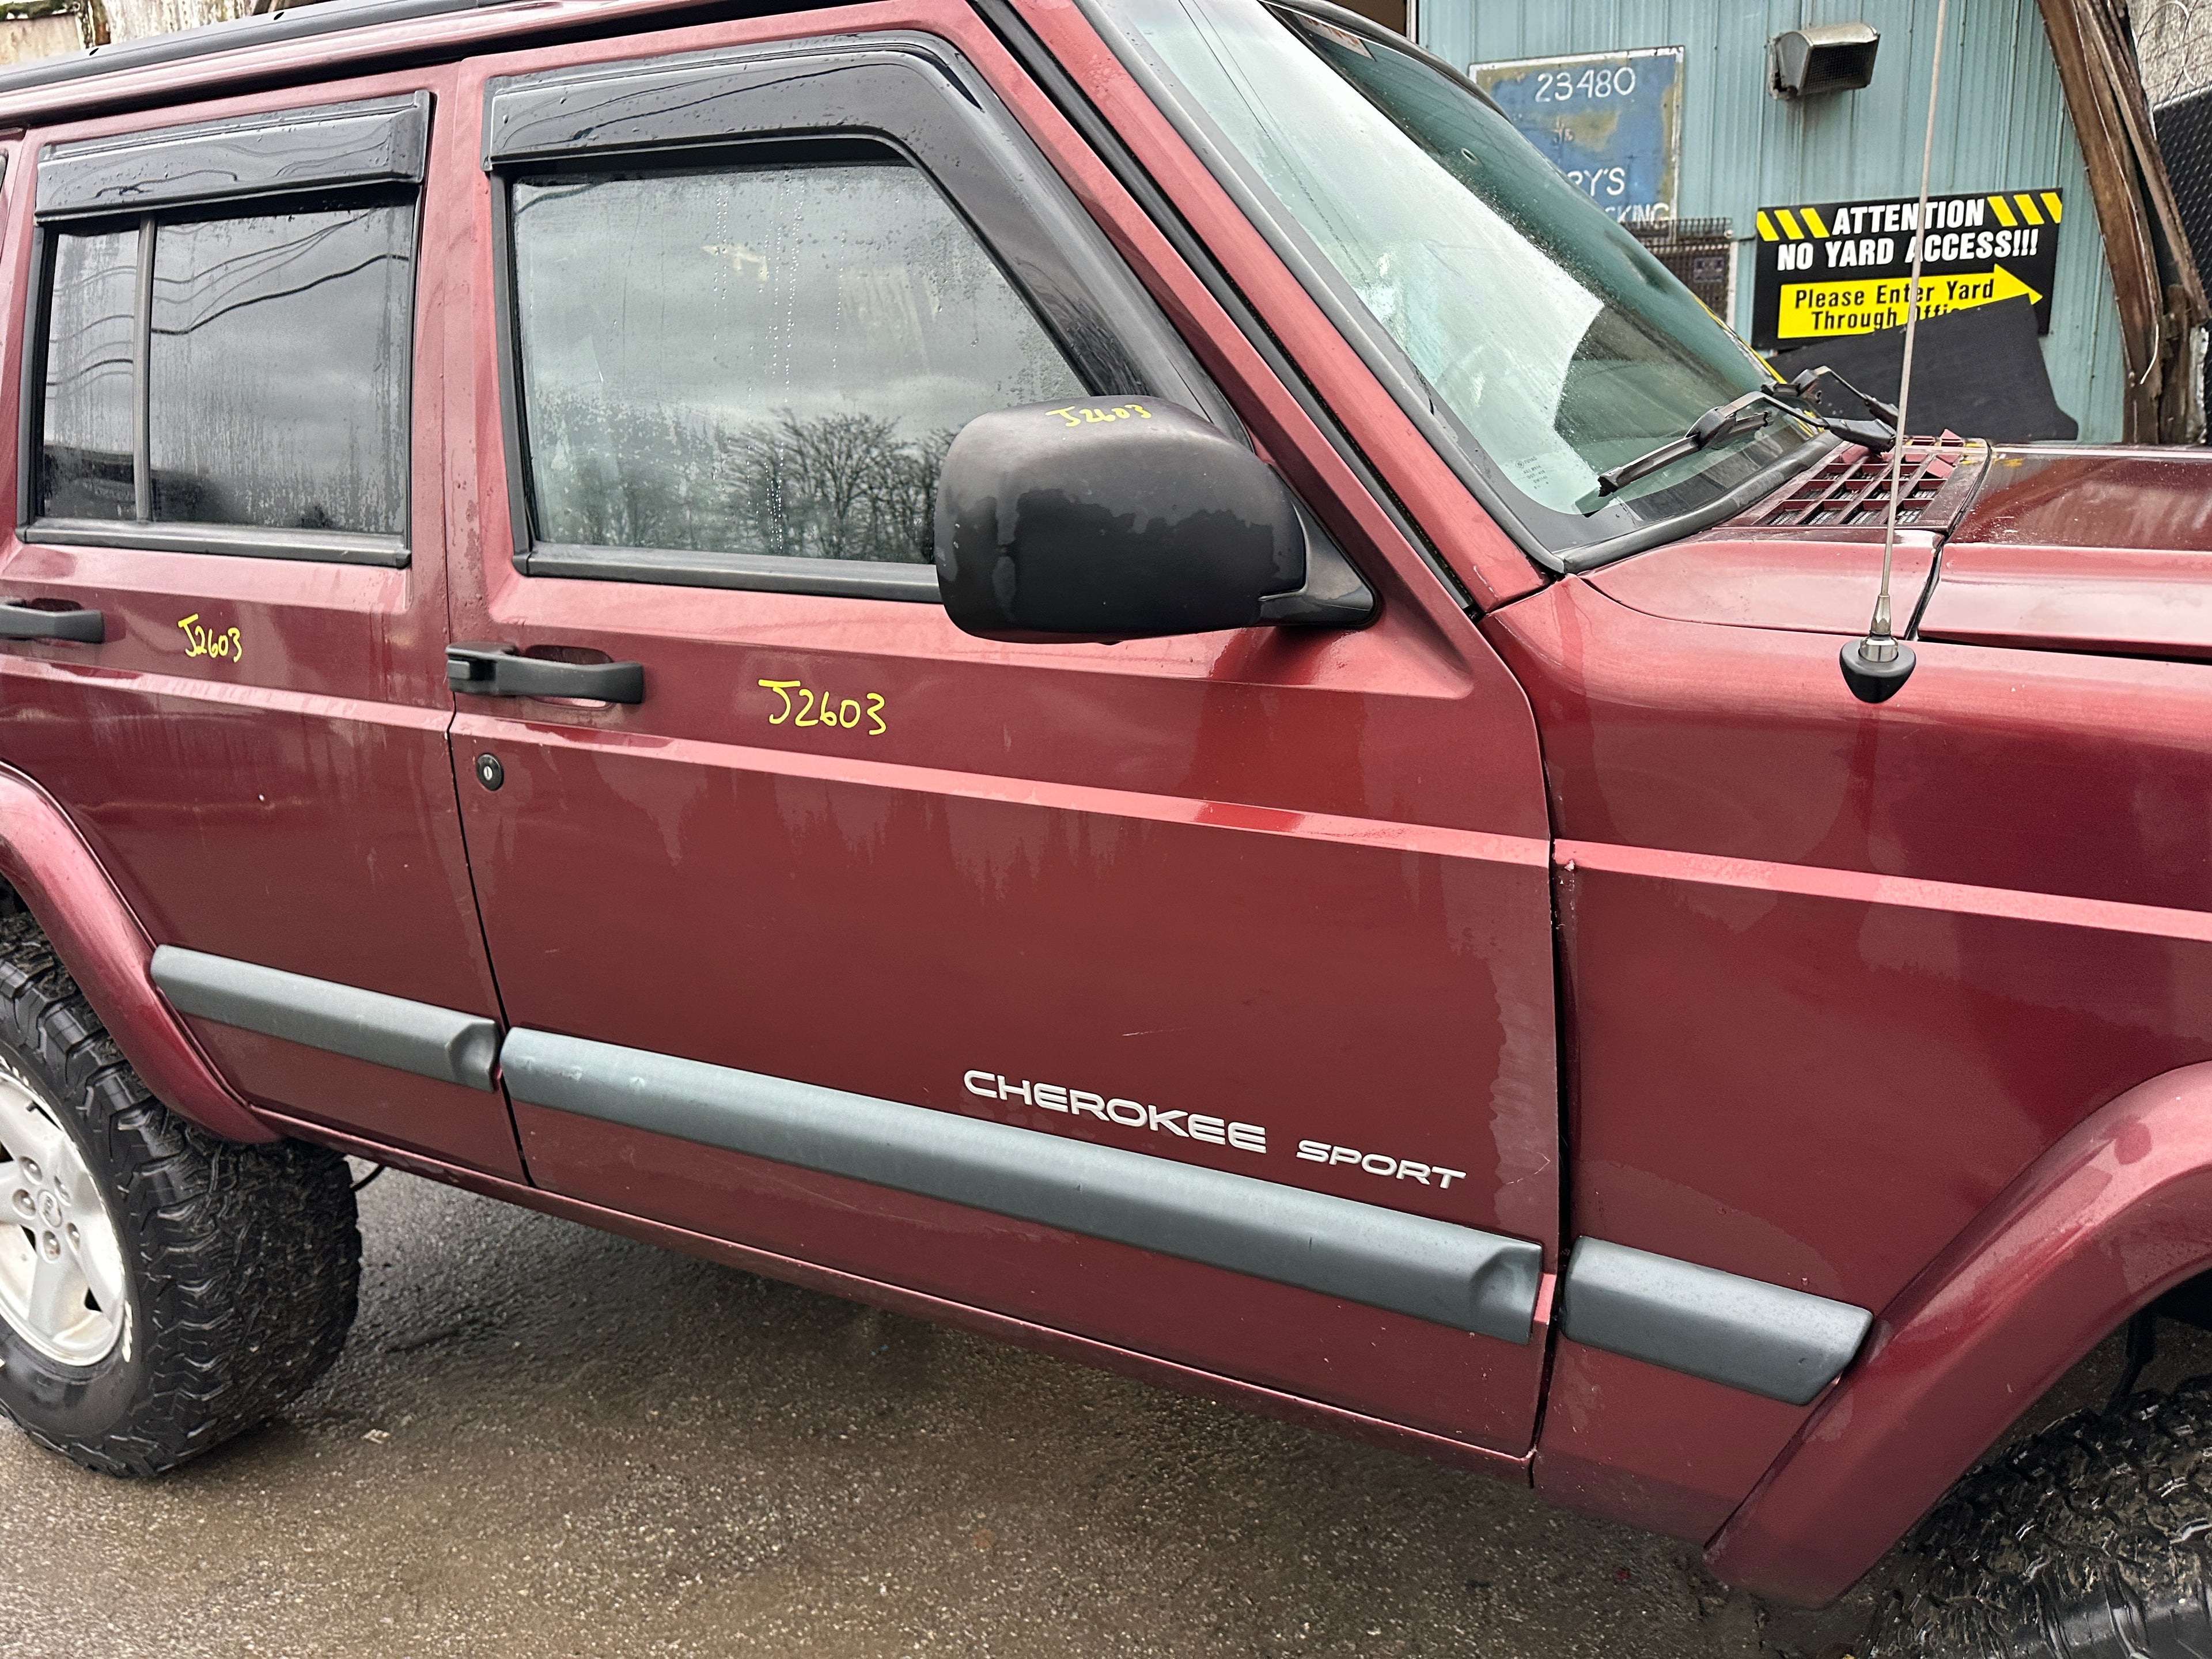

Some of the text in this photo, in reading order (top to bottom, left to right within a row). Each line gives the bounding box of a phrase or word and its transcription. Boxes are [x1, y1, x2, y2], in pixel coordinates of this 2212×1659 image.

[1535, 66, 1636, 103] 23480
[1832, 199, 1984, 236] ATTENTION
[1777, 229, 2039, 271] NO YARD ACCESS!!!
[1795, 279, 1994, 309] Please Enter Yard
[1811, 306, 1897, 330] Through
[177, 613, 243, 662] J2603
[758, 679, 887, 735] J2603
[963, 1070, 1467, 1189] CHEROKEE SPORT
